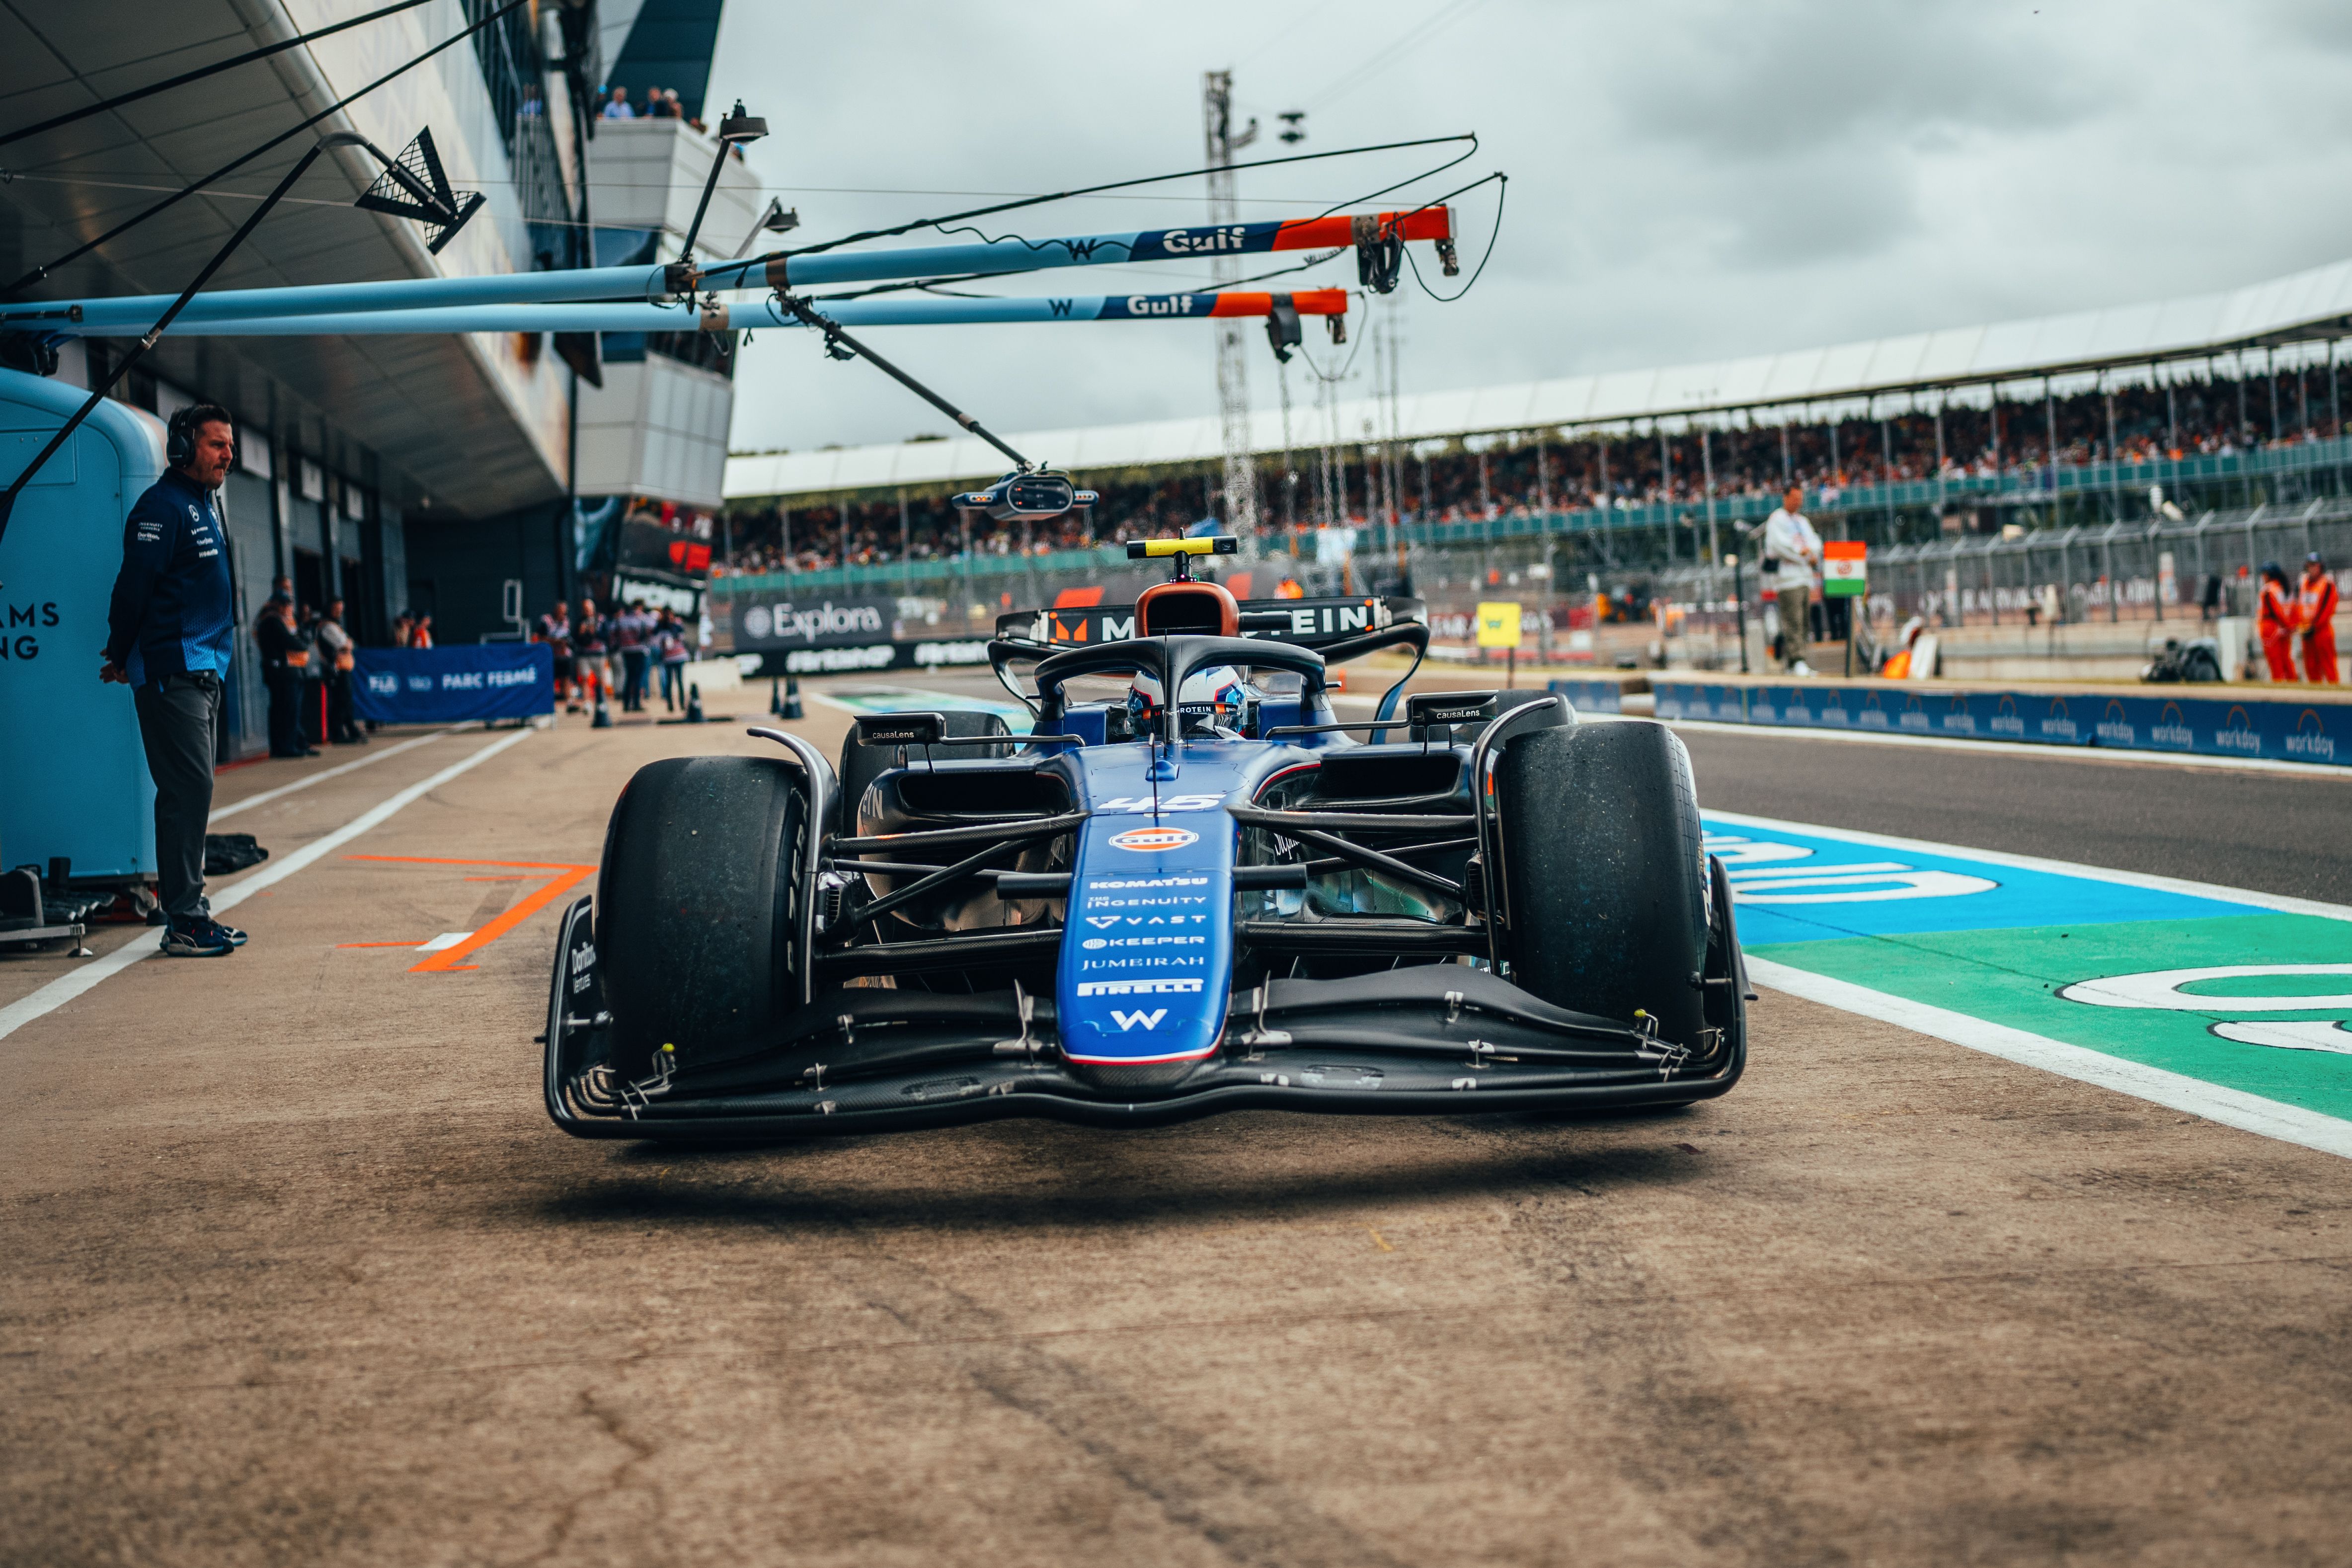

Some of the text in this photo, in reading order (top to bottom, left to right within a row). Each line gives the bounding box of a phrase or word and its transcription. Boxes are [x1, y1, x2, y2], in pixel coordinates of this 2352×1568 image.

[1163, 227, 1246, 252] Gulf
[1127, 295, 1192, 314] Gulf
[0, 602, 59, 628] MS
[774, 601, 881, 642] Explora
[442, 672, 483, 689] PARC
[1437, 710, 1480, 719] causaLens
[2097, 720, 2134, 744] workday
[2152, 722, 2194, 750] workday
[2216, 725, 2261, 755] workday
[2286, 731, 2334, 761] workday
[1097, 794, 1227, 812] 45
[1115, 835, 1192, 844] Gulf
[1090, 877, 1208, 889] KOMATSU
[1126, 915, 1206, 925] VAST
[1110, 936, 1205, 946] KEEPER
[1081, 956, 1204, 971] JUMEIRAH
[1077, 978, 1204, 997] PIRELLI
